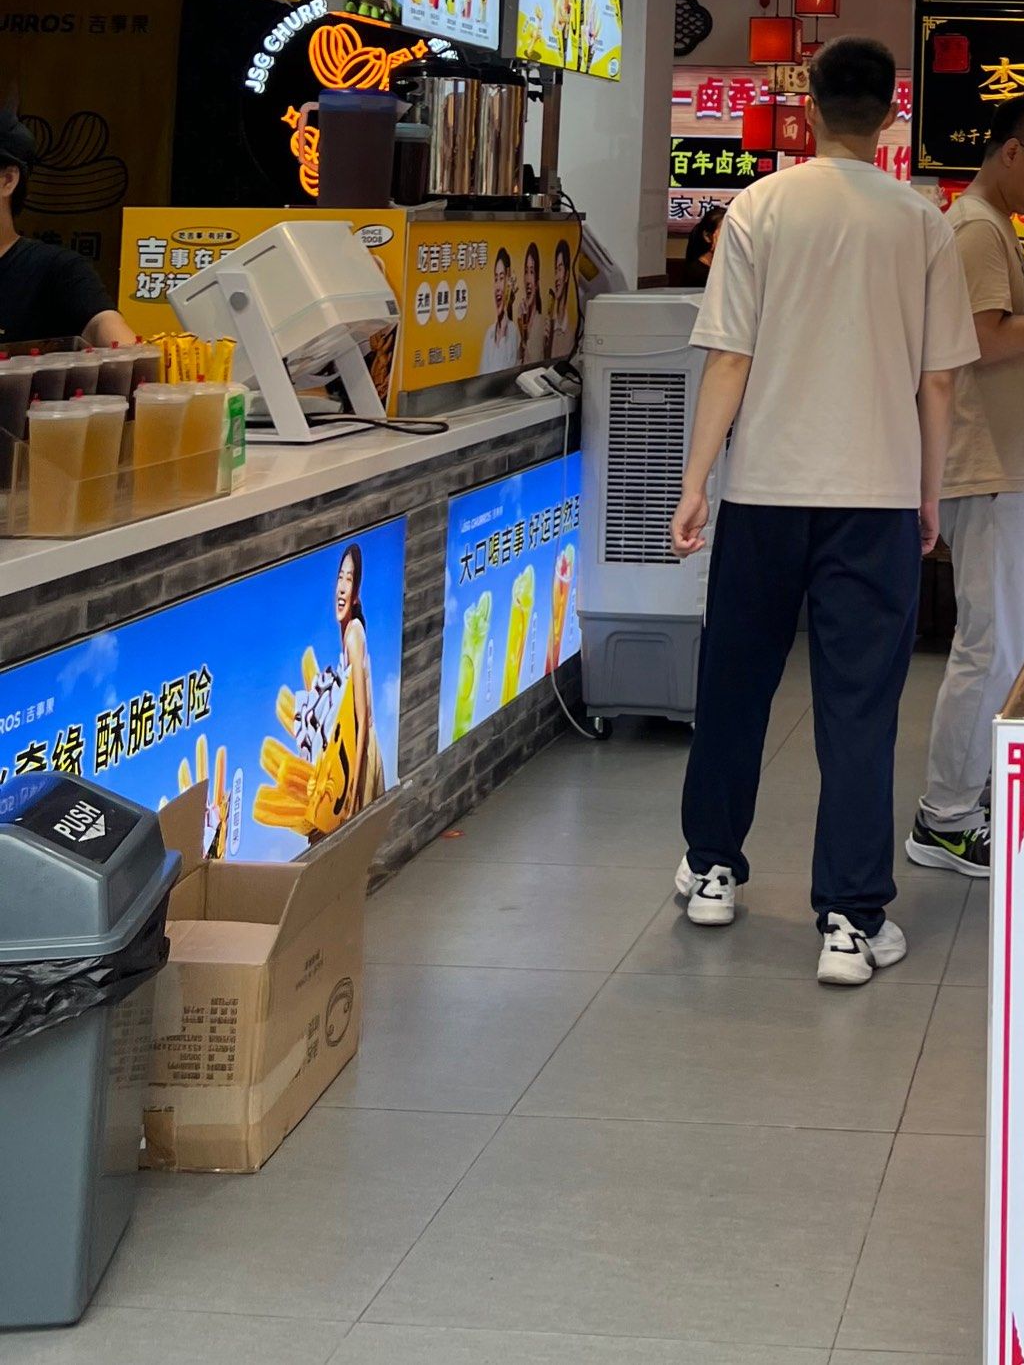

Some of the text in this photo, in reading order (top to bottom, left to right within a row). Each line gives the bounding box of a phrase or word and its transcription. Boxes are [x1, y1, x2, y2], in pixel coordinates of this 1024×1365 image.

[671, 150, 758, 176] 百年卤煮
[670, 196, 735, 221] 家族
[94, 666, 212, 774] 酥脆探险
[53, 800, 102, 842] PUSH
